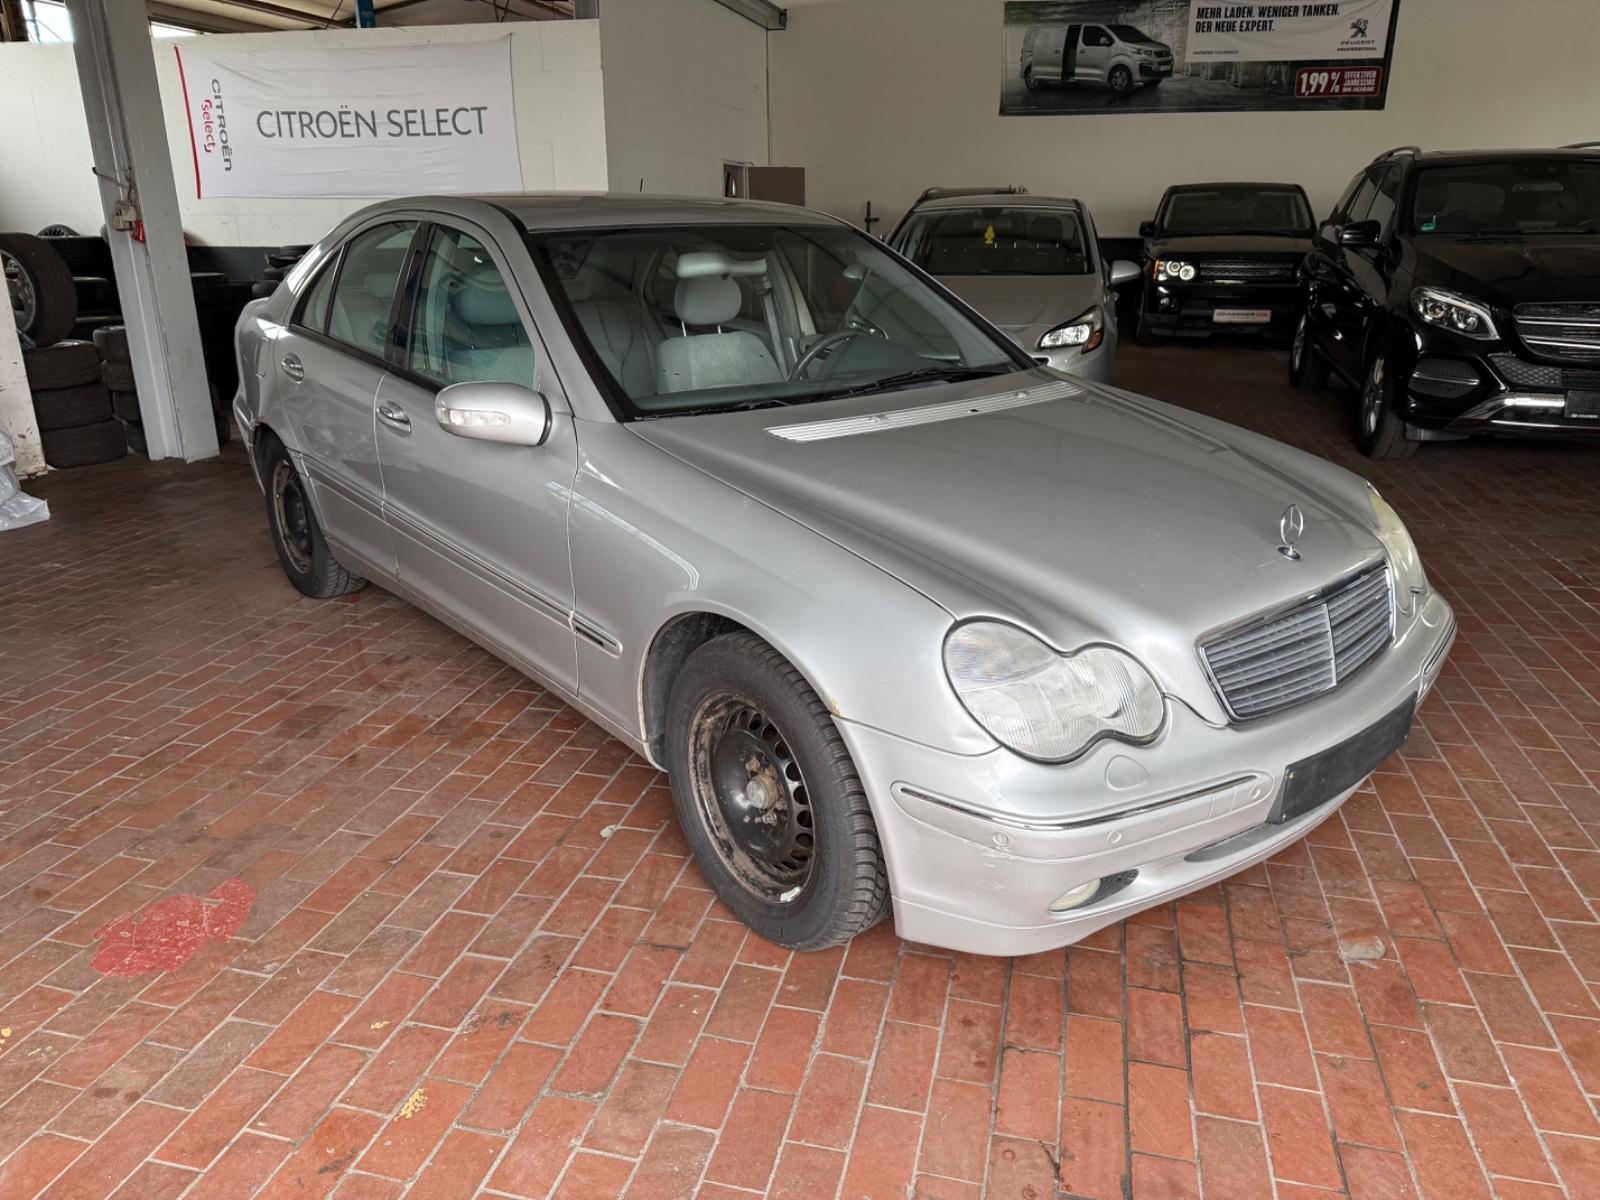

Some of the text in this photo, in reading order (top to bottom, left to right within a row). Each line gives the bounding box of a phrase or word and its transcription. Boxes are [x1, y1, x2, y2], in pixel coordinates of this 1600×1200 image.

[1197, 3, 1340, 19] MEHR LADEN. WENIGER TANKEN.
[1195, 19, 1275, 33] DER NEUE EXPERT.
[1300, 72, 1329, 96] 1,99
[256, 104, 488, 138] CITROËN SELECT
